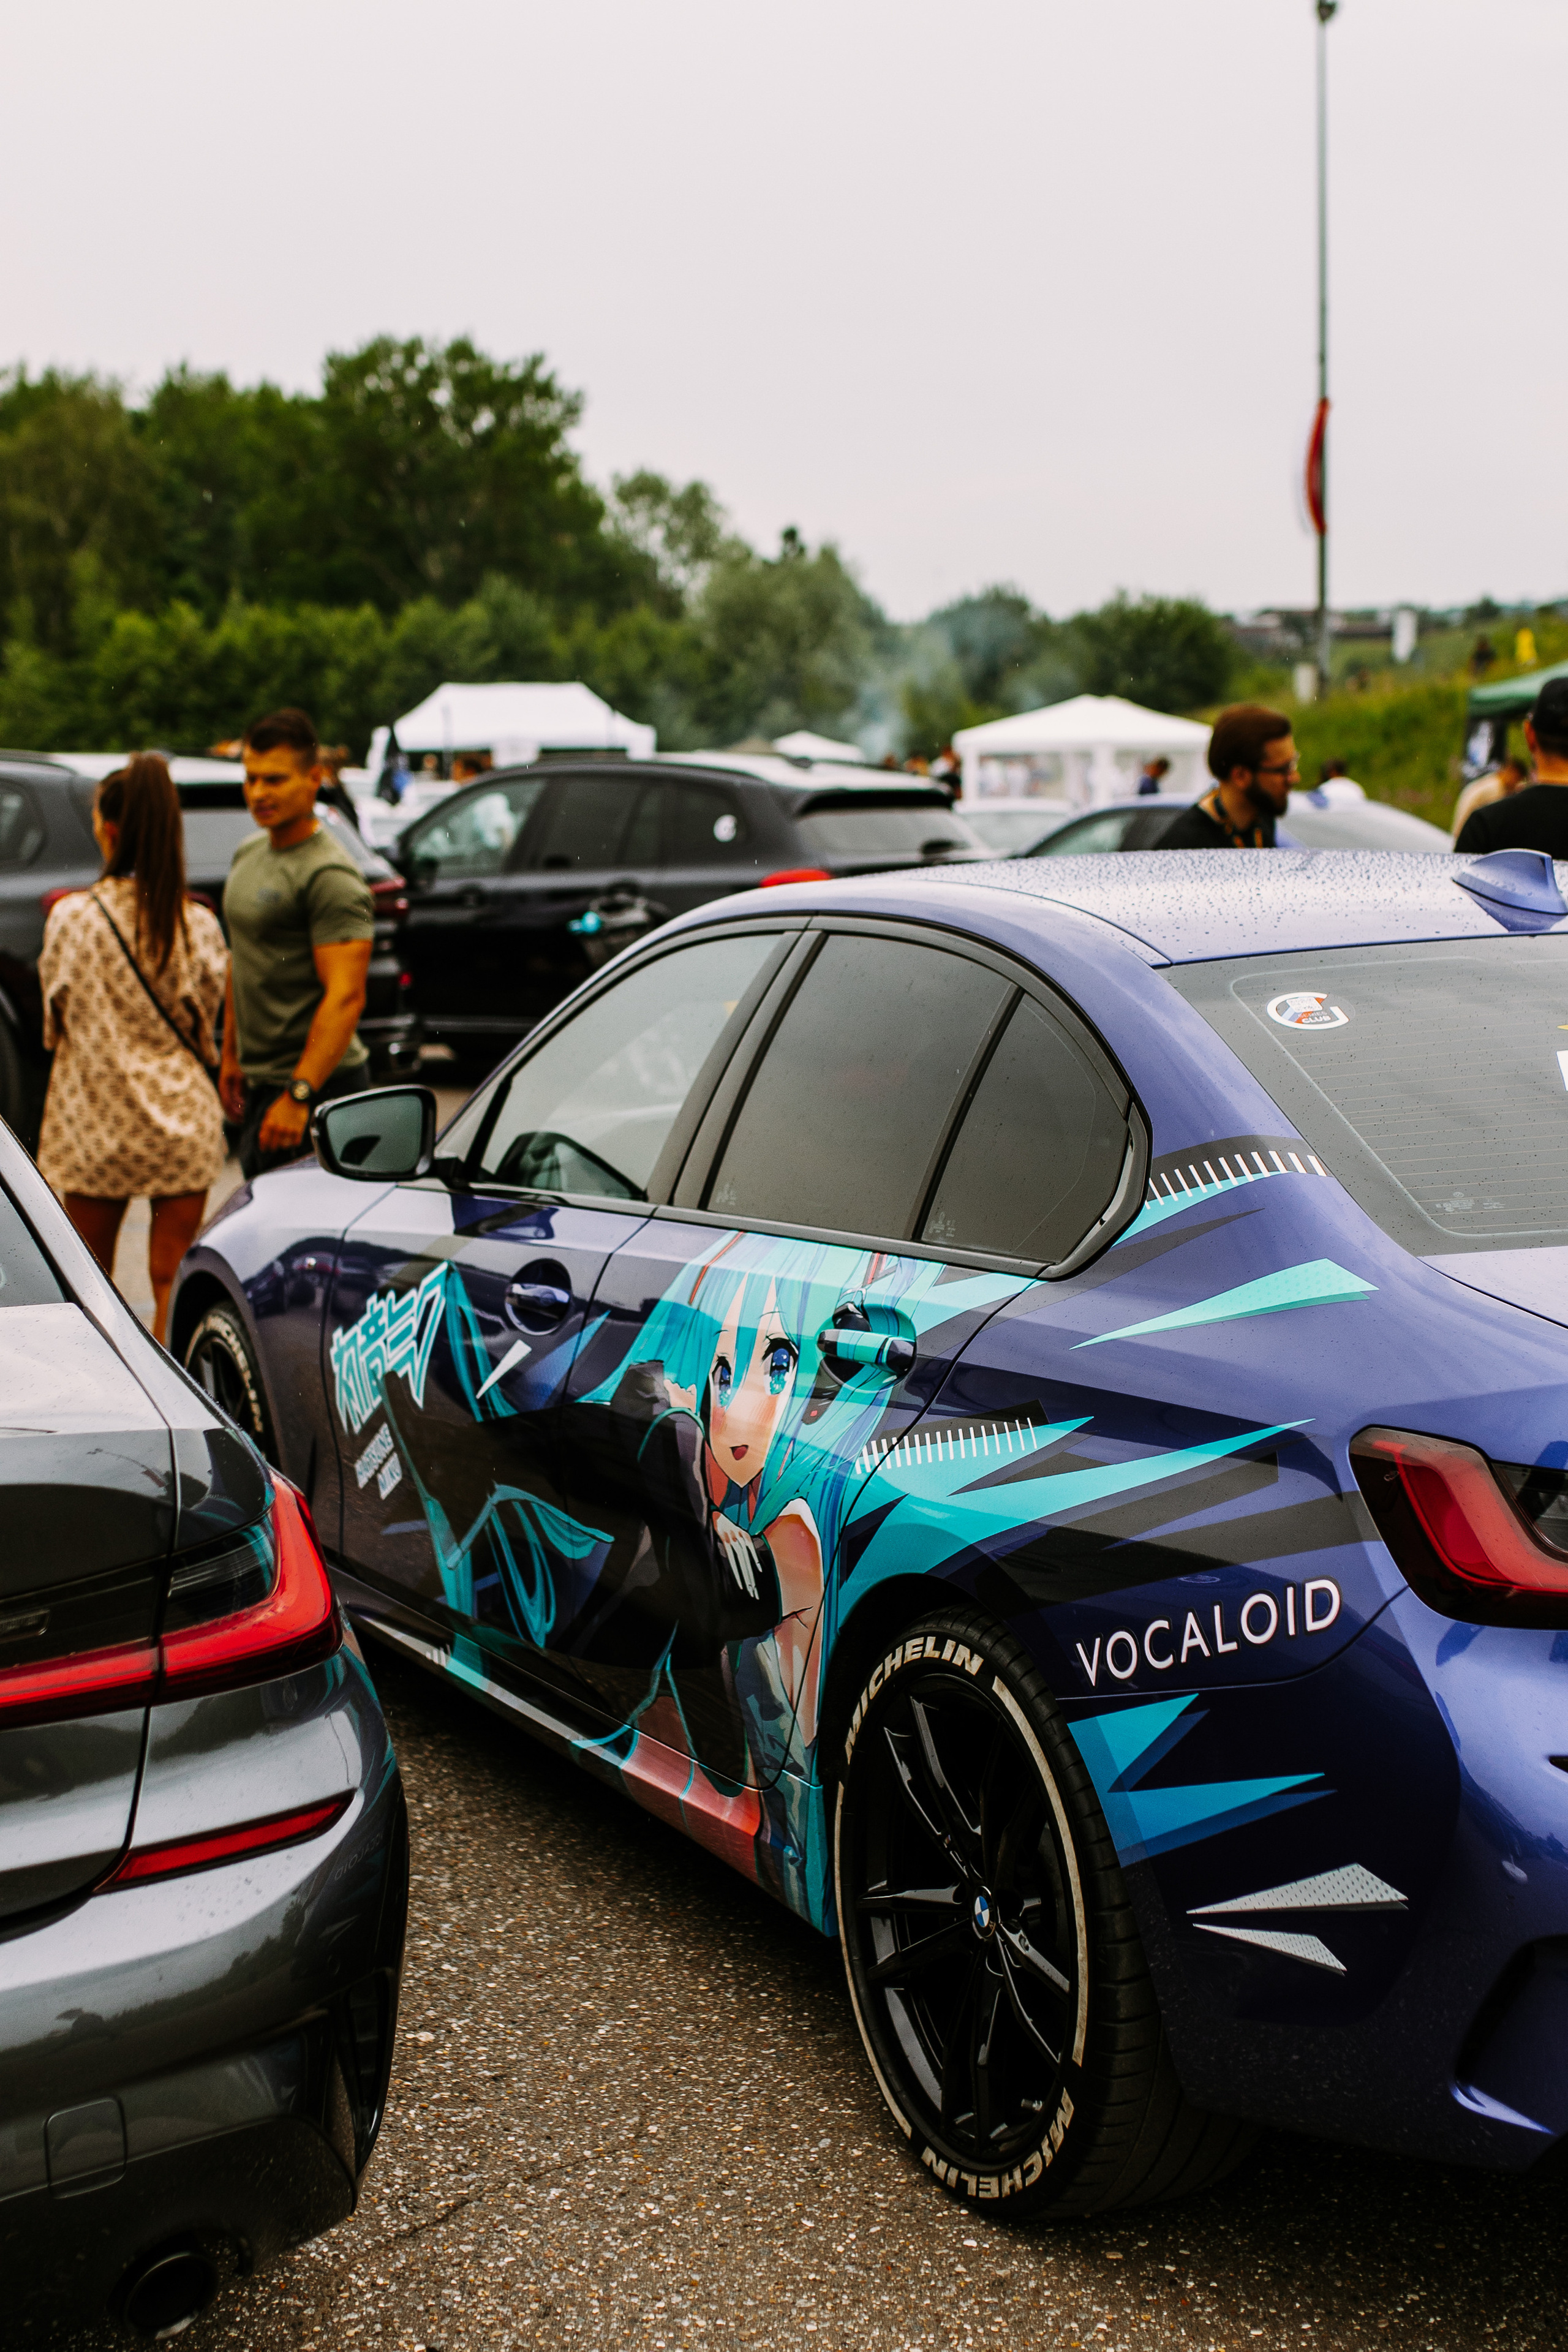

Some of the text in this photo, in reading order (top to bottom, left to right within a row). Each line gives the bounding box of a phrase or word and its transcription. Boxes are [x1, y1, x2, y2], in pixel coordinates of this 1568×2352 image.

[1302, 1015, 1332, 1024] CLUB
[1076, 1578, 1341, 1686] VOCALOID
[845, 1636, 984, 1765] MICHELIN
[921, 2086, 1074, 2198] MICHELIN
